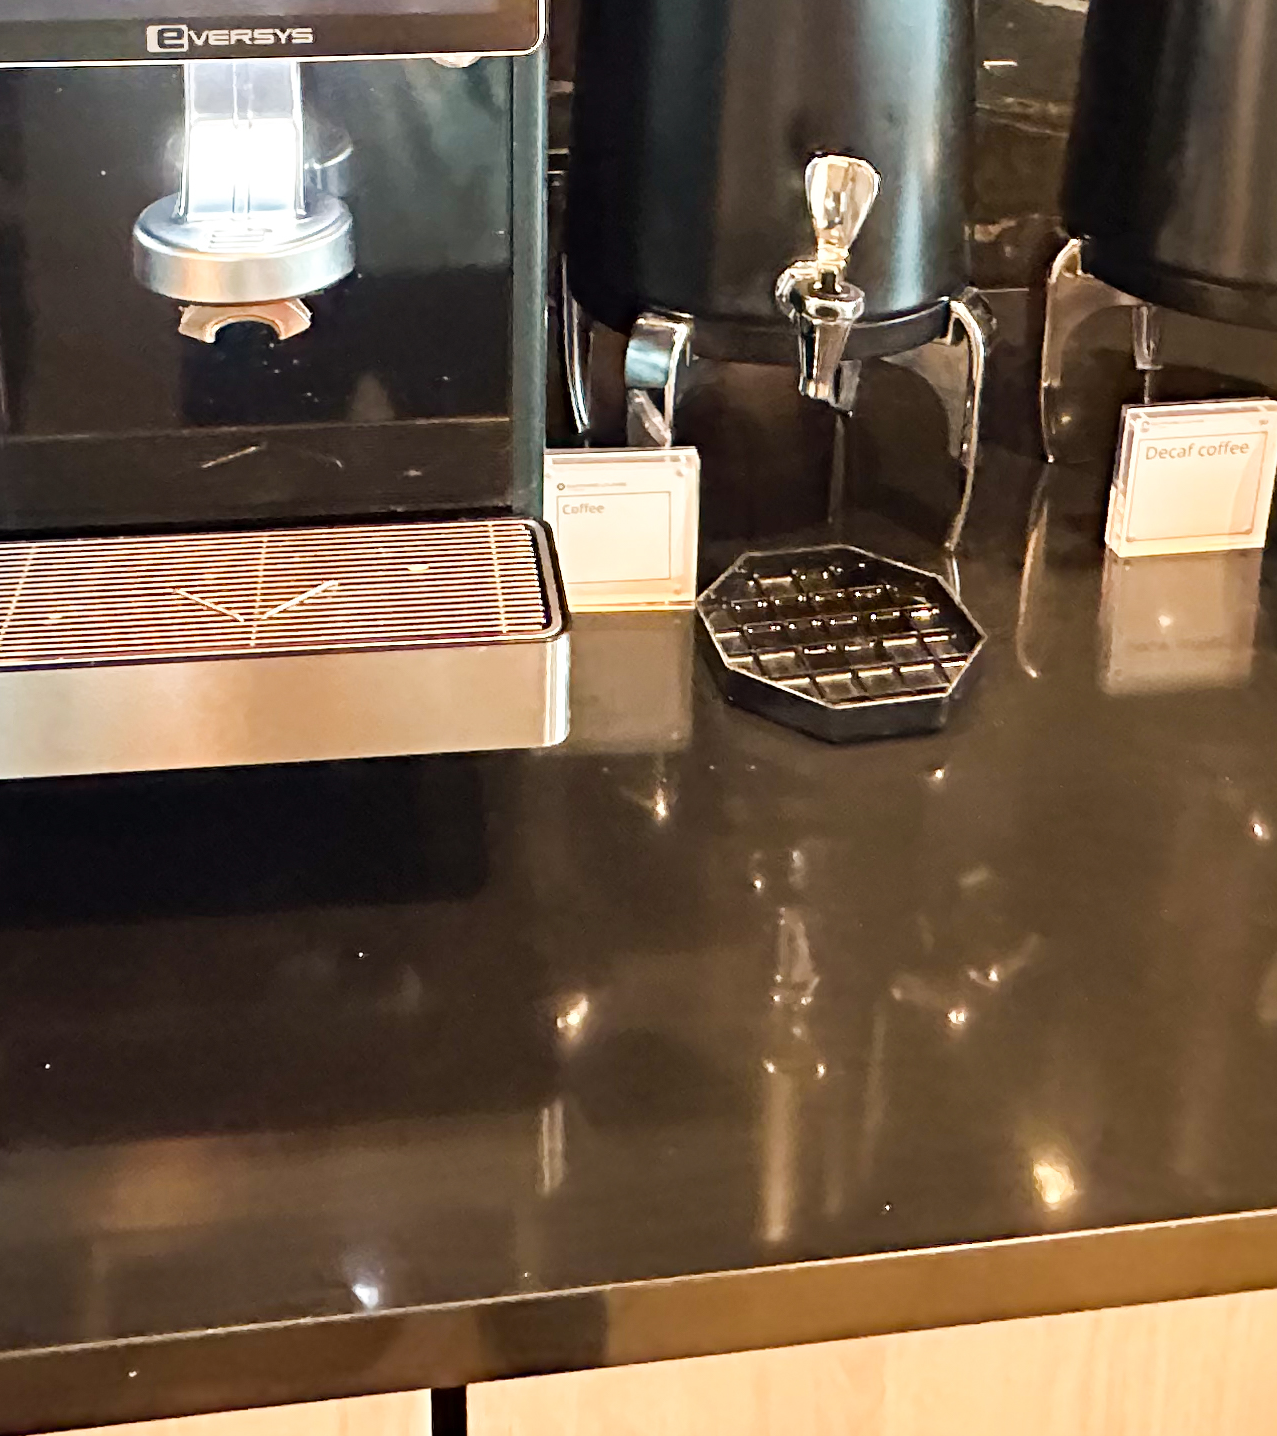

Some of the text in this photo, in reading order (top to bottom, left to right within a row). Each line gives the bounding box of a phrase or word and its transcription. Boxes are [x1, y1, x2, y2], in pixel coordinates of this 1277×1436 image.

[1145, 440, 1250, 460] Decaf coffee
[562, 503, 605, 515] Coffee
